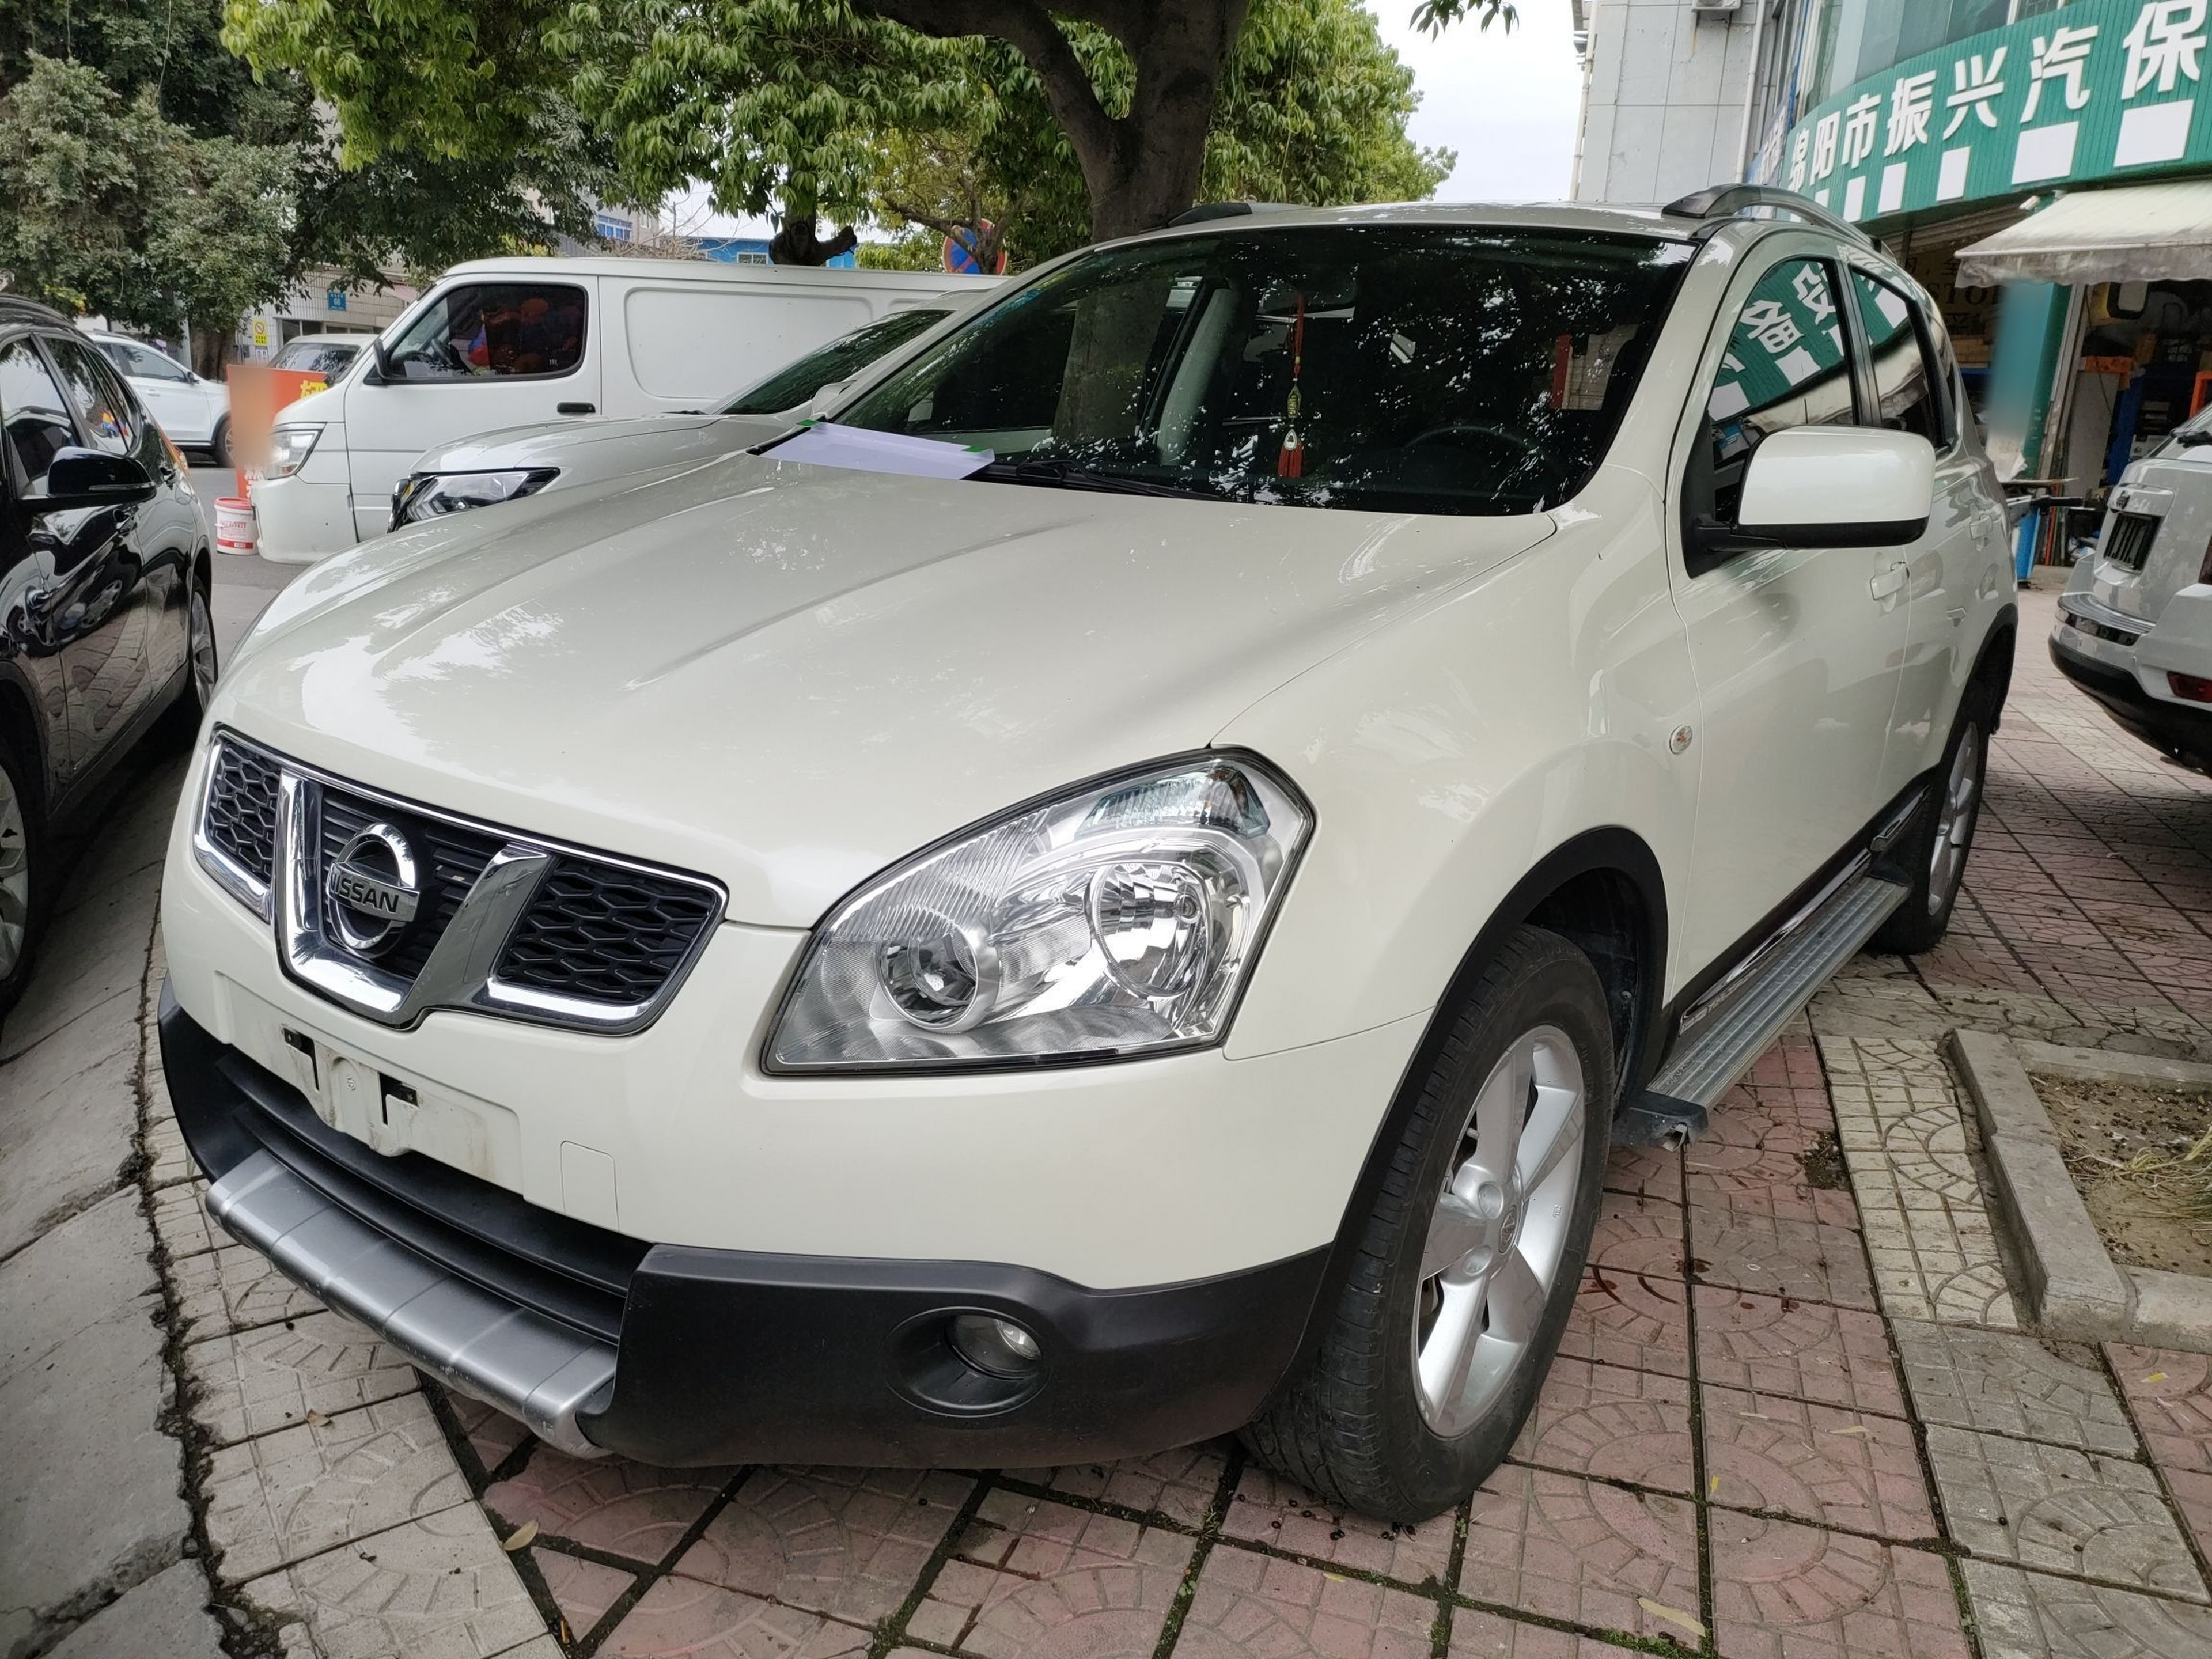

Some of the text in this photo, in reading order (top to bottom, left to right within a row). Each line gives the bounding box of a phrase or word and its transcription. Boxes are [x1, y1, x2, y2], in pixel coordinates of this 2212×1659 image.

[1788, 0, 2208, 193] 绵阳市振兴汽保
[331, 872, 400, 913] NISSAN
